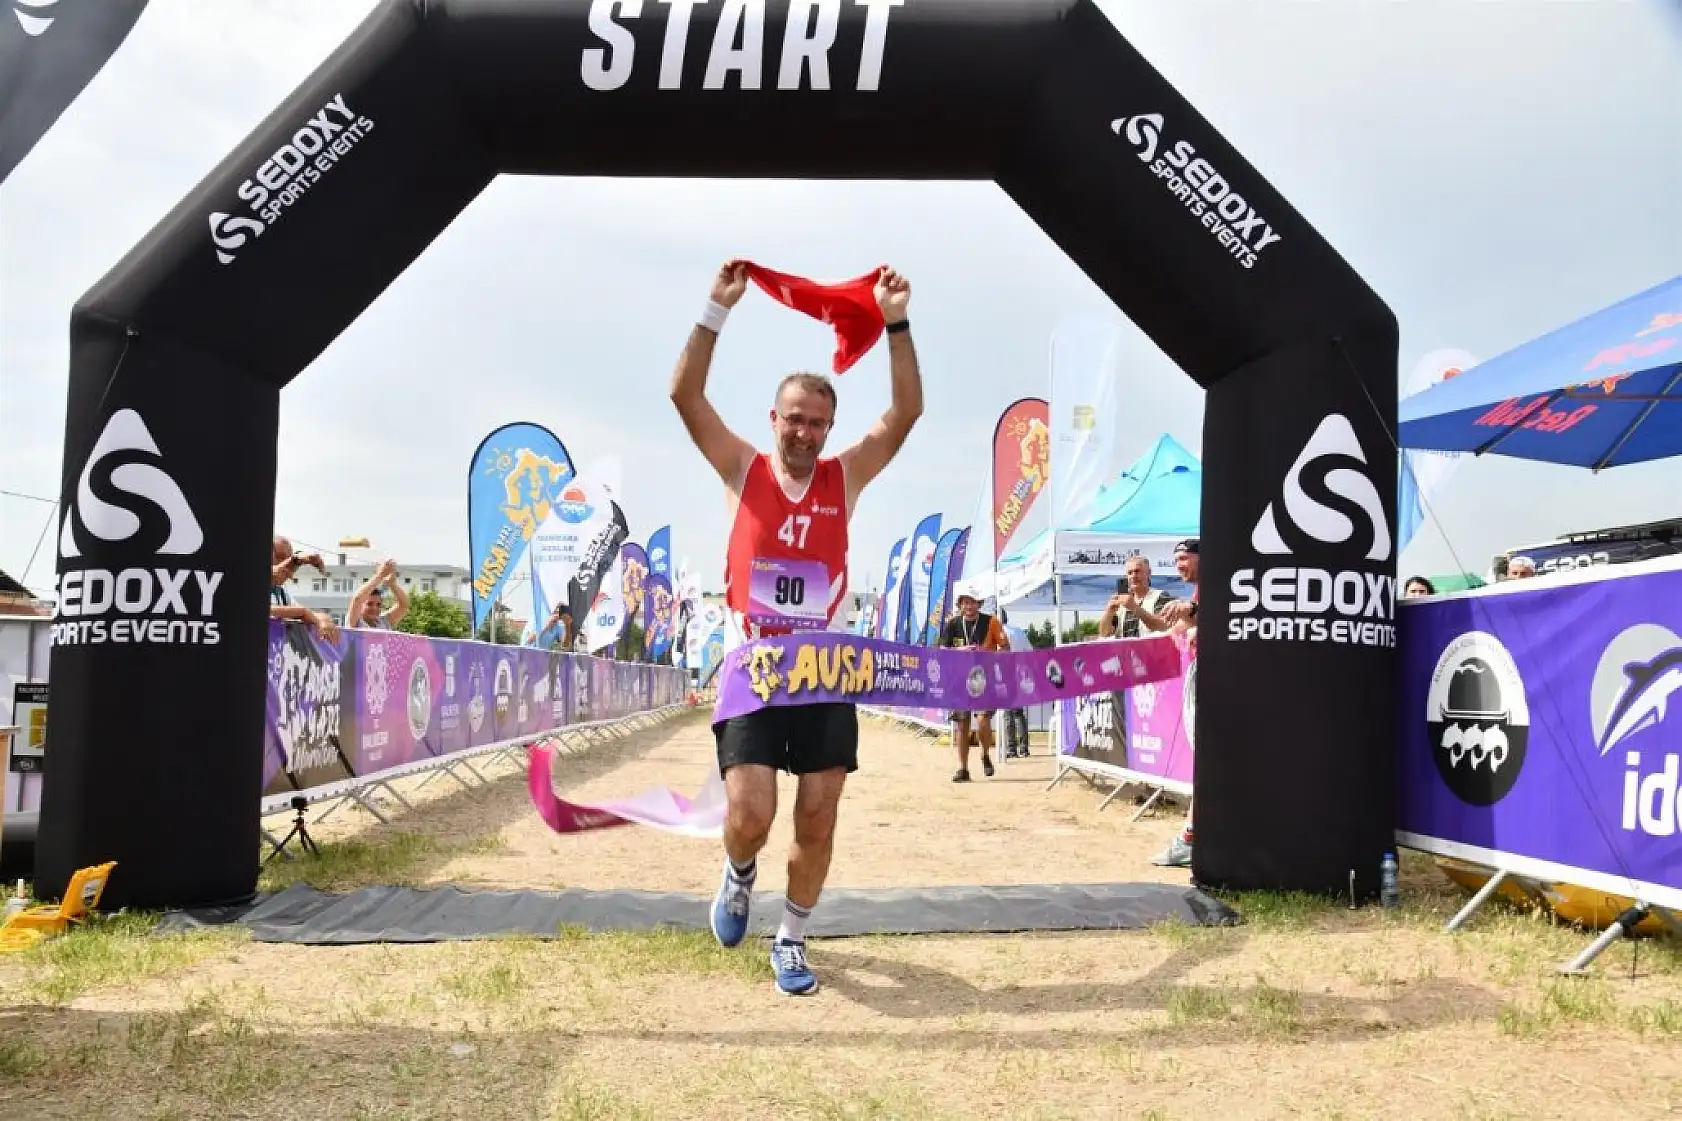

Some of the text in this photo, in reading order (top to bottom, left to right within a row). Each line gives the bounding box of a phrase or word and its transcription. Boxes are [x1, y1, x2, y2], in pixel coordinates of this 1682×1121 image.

[581, 0, 904, 91] START
[238, 93, 355, 211] SEDOXY
[260, 116, 375, 225] SPORTS EVENTS
[1149, 159, 1257, 269] SPORTS EVENTS
[1163, 140, 1282, 252] SEDOXY
[777, 514, 812, 550] 47
[50, 619, 220, 646] PORTS EVENTS
[775, 575, 804, 606] 90
[1228, 618, 1327, 642] SPORTS
[1229, 567, 1396, 619] SEDOXY
[1622, 751, 1682, 836] id
